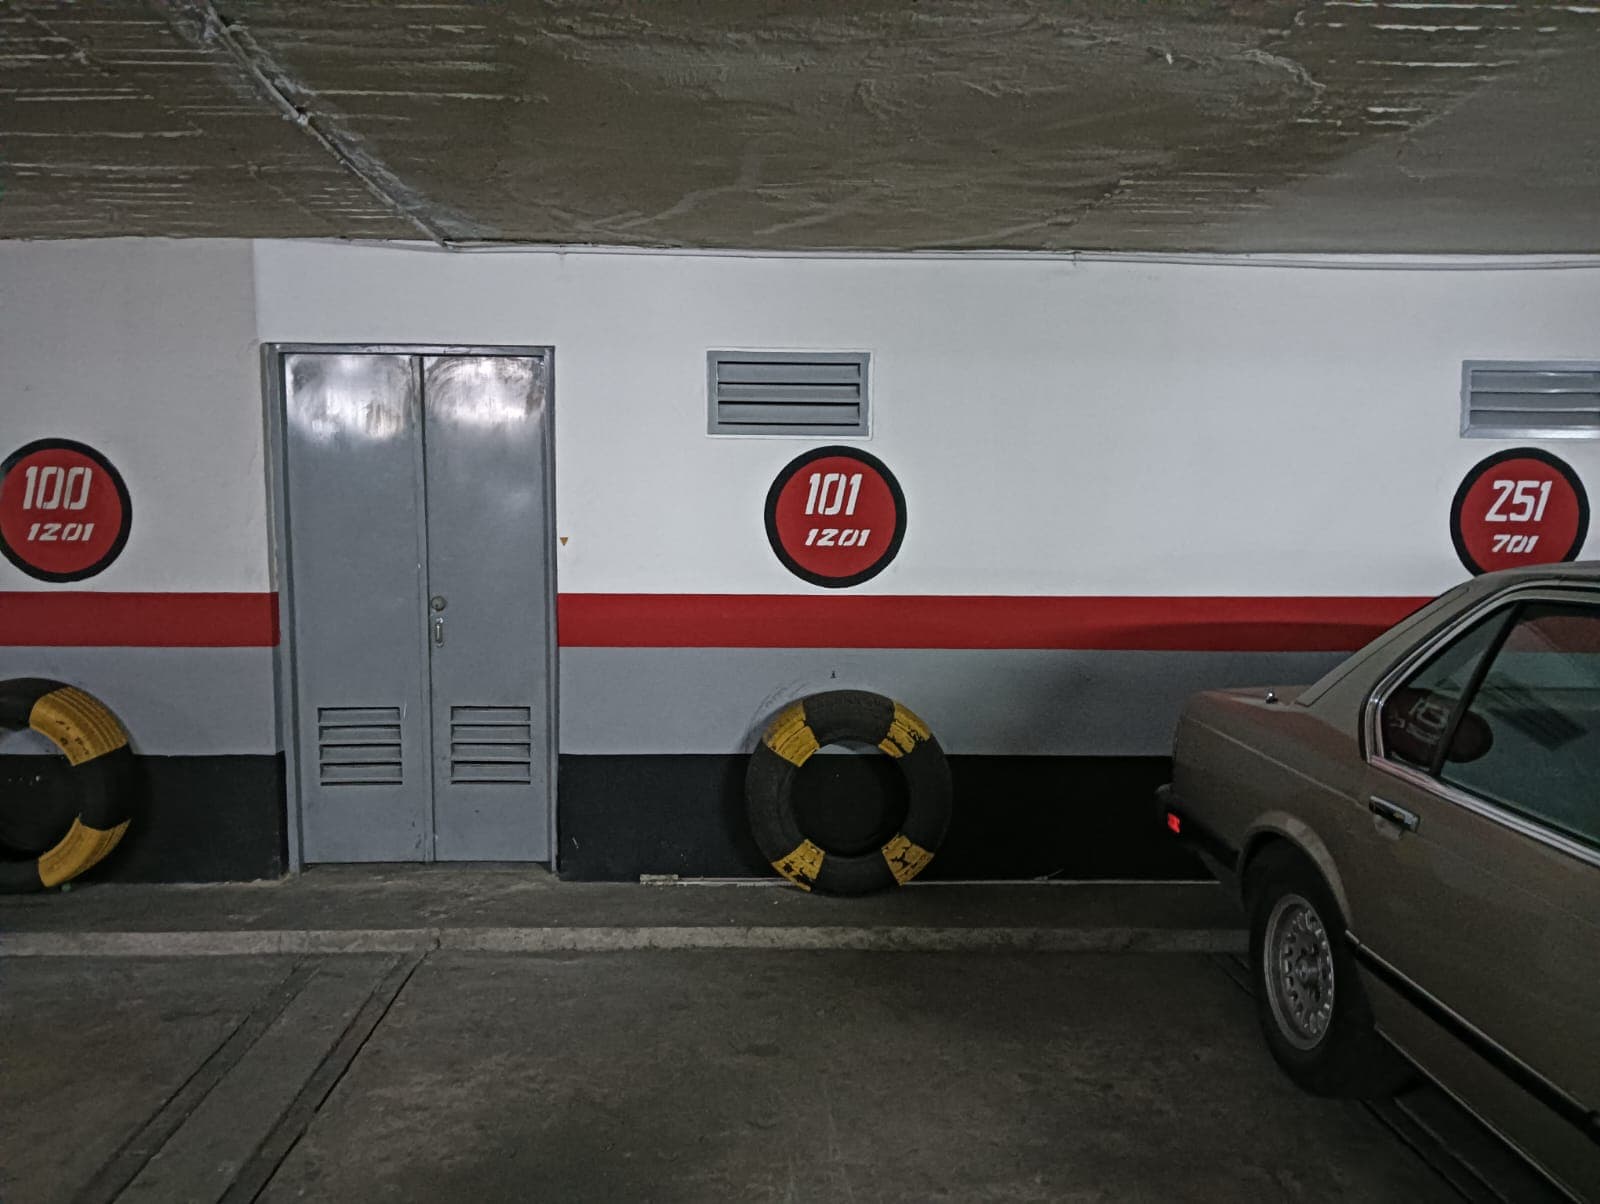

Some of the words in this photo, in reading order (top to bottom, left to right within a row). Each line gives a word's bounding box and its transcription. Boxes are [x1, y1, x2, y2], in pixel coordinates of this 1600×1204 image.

[23, 466, 93, 510] 100
[804, 472, 863, 516] 101
[1484, 479, 1553, 522] 251
[27, 523, 95, 541] 1201
[804, 528, 871, 547] 1201
[1491, 534, 1540, 554] 701
